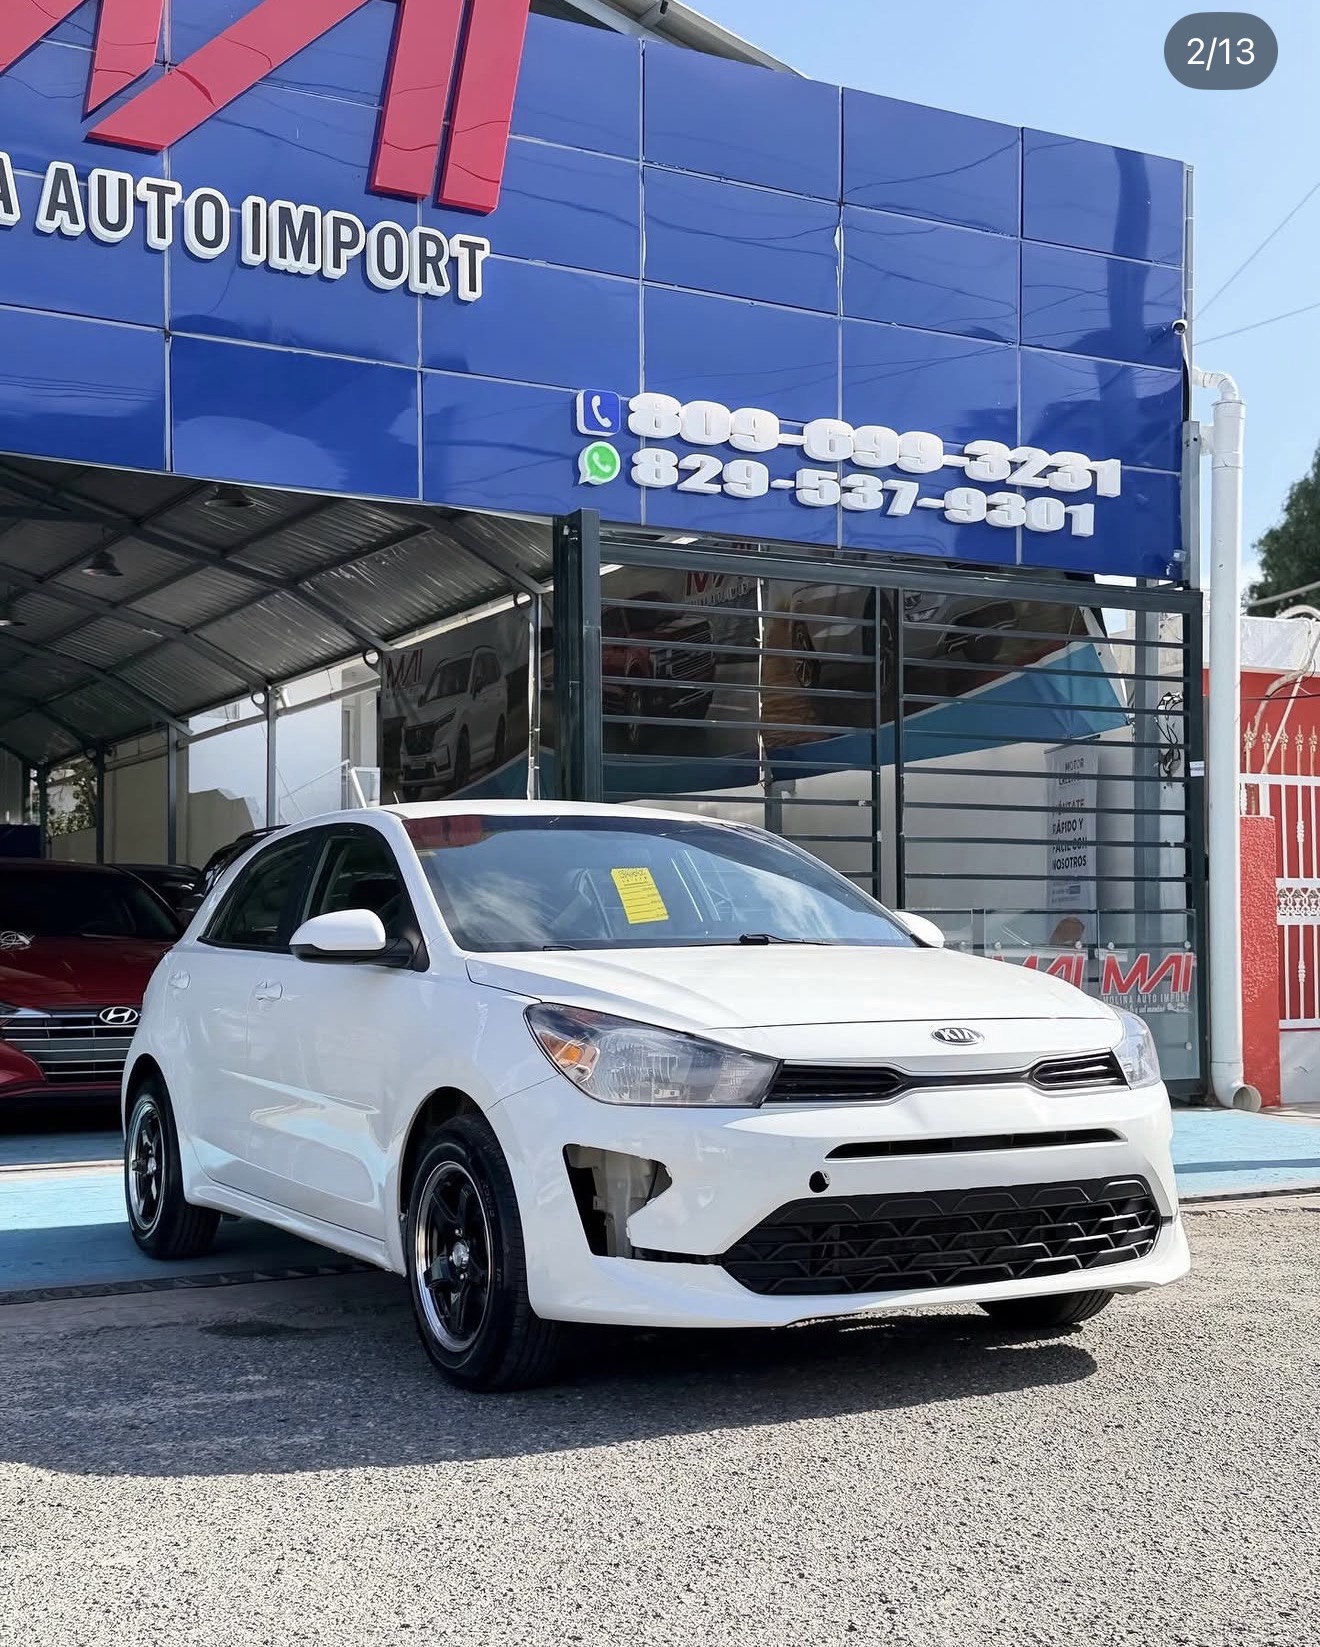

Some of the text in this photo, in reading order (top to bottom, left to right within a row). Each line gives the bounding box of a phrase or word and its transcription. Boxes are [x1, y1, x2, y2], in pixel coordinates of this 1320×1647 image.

[36, 161, 230, 259] AUTO
[242, 195, 490, 302] IMPORT
[628, 393, 1121, 497] 809-699-3231
[631, 448, 1095, 537] 829-537-9301
[1065, 758, 1084, 771] MOTOR
[1078, 817, 1084, 830] Y
[1052, 855, 1087, 871] NOSOTROS
[1101, 952, 1194, 995] MAI
[1102, 992, 1190, 1004] MOLINA AUTO IMPORT
